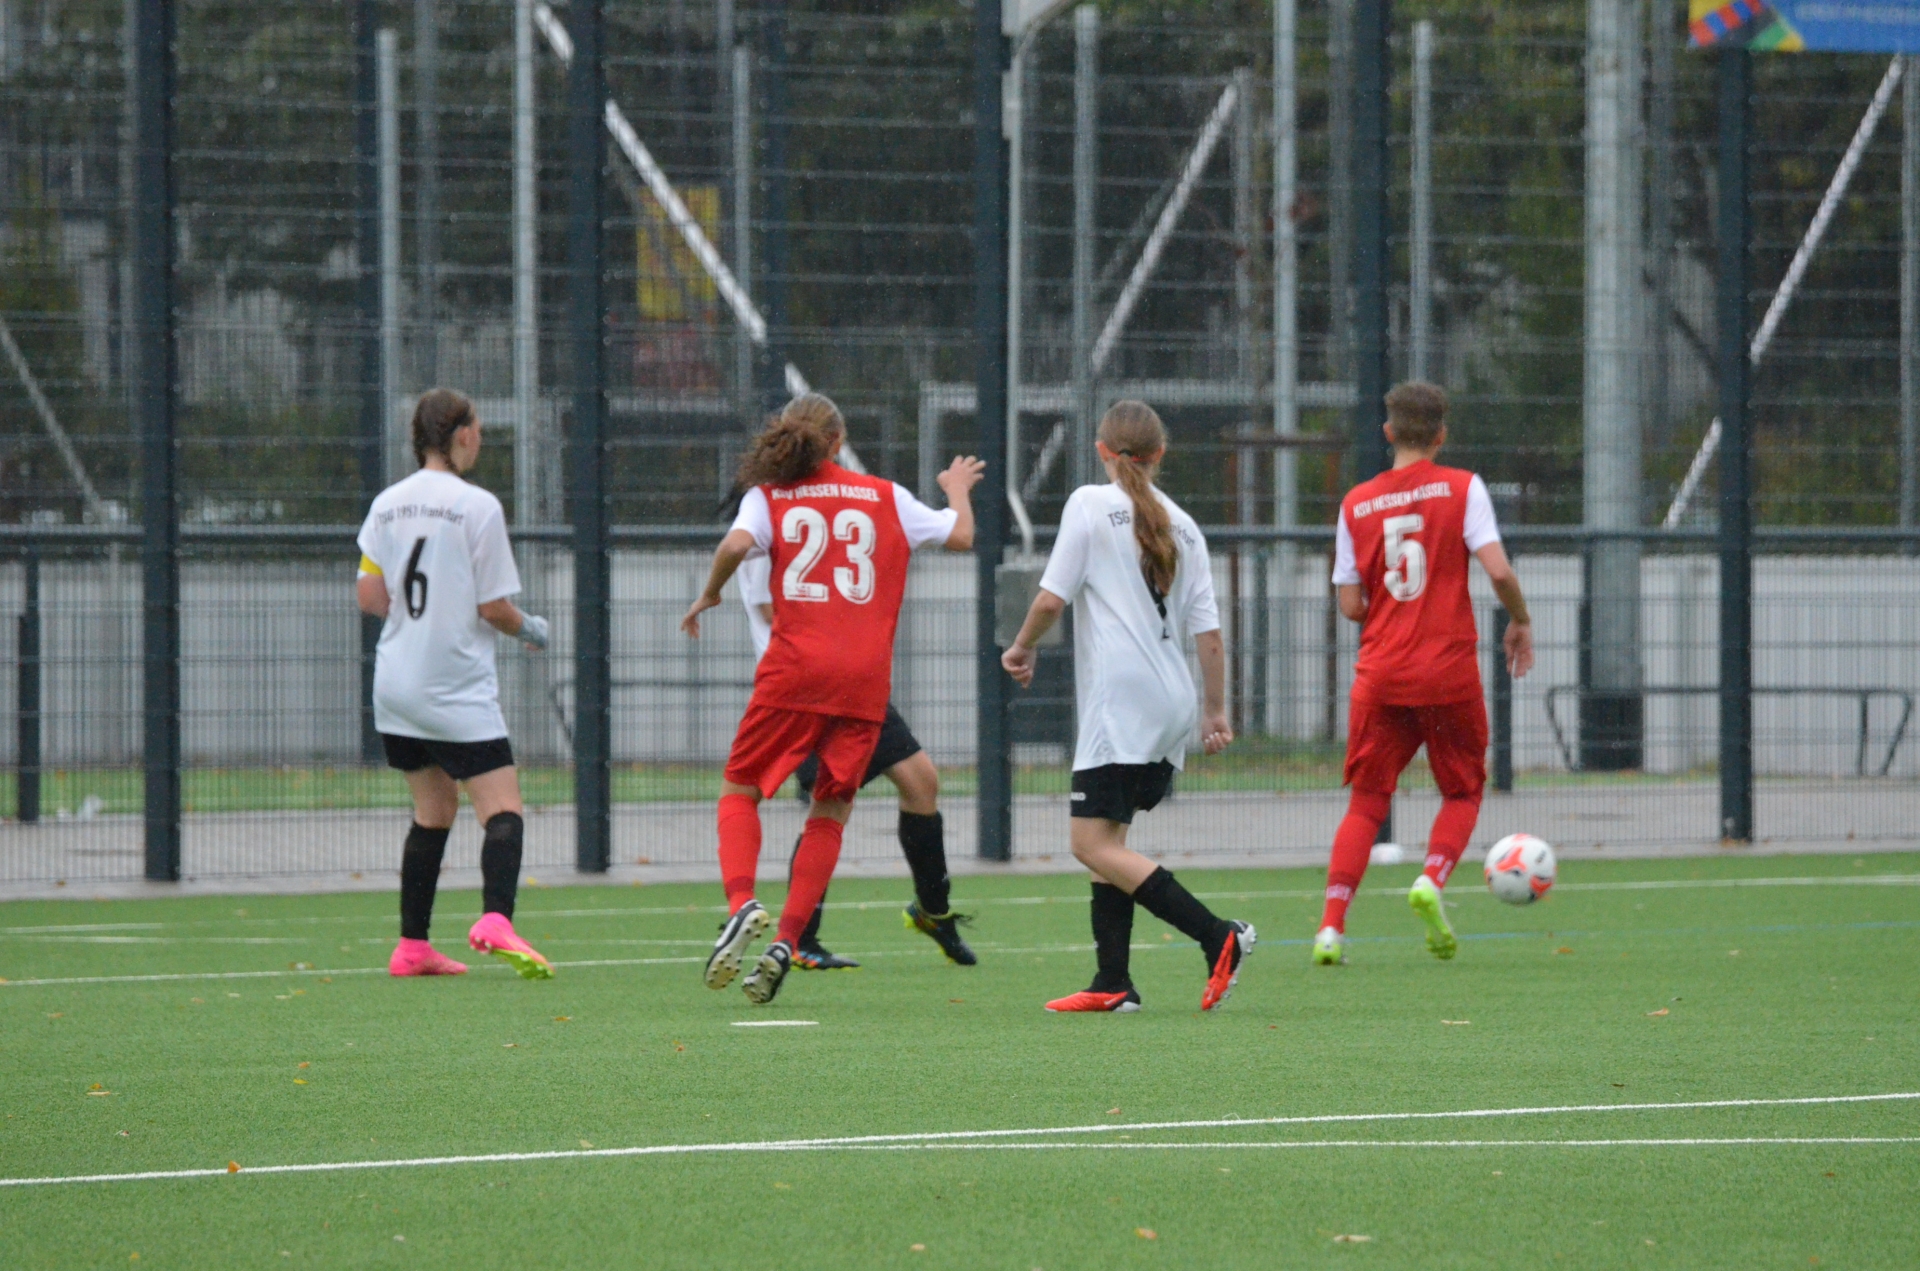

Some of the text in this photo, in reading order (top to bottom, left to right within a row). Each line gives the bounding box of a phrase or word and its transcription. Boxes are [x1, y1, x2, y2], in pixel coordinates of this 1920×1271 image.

[795, 483, 840, 500] HESSEN
[840, 484, 881, 502] KASSEL
[1353, 481, 1451, 519] KSV HESSEN KASSEL
[420, 503, 464, 526] Frankfurt
[1107, 510, 1131, 527] TSG
[781, 506, 877, 604] 23
[1382, 513, 1428, 602] 5
[403, 535, 429, 621] 6
